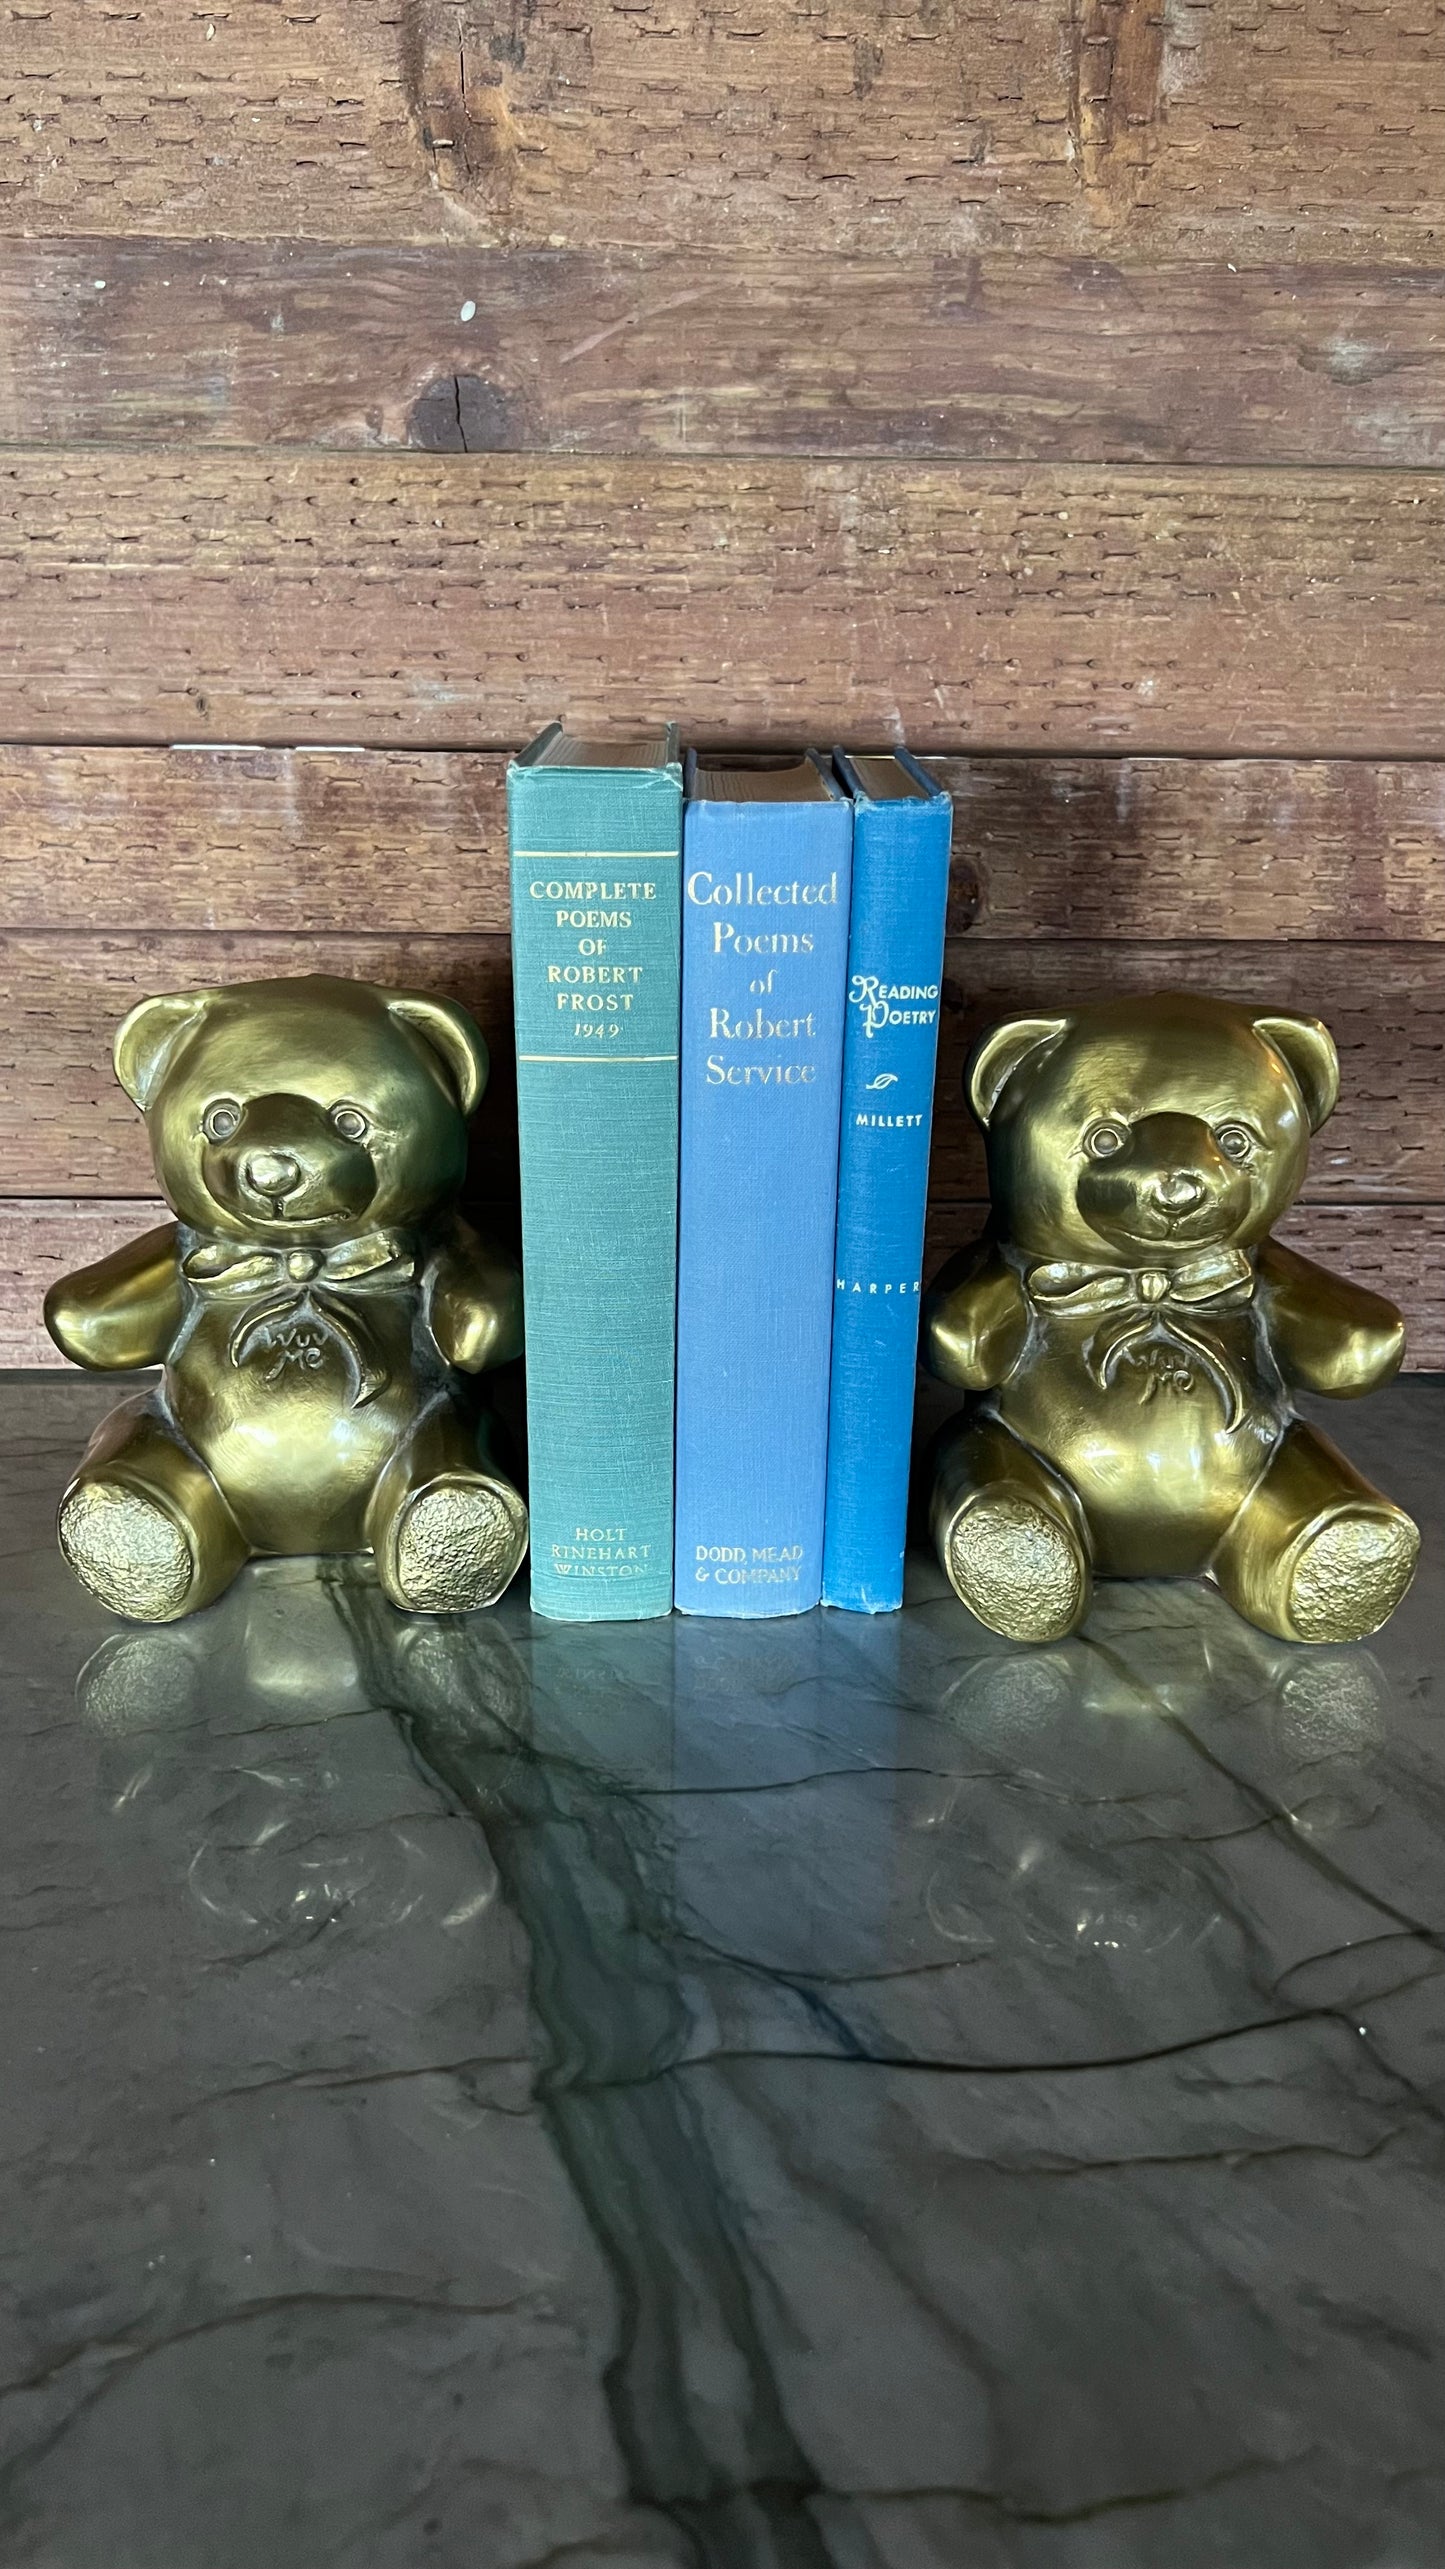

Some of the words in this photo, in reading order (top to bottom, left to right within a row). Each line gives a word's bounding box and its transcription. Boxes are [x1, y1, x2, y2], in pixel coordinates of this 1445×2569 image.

[529, 881, 656, 900] COMPLETE
[687, 871, 837, 906] Collected
[556, 910, 631, 928] POEMS
[578, 938, 608, 956] OF
[713, 921, 814, 955] Poems
[547, 965, 643, 983] ROBERT
[749, 969, 777, 994] of
[848, 975, 938, 1003] READING
[557, 994, 634, 1011] FROST
[709, 1007, 816, 1039] Robert
[859, 1000, 936, 1038] POETRY
[573, 1022, 620, 1038] 1949
[706, 1059, 816, 1086] Service
[856, 1114, 923, 1127] MILLETT
[836, 1279, 920, 1294] HARPER
[576, 1528, 627, 1541] HOLT
[551, 1544, 651, 1560] RINEHART
[696, 1545, 747, 1565] DODD,
[752, 1545, 803, 1562] MEAD
[554, 1563, 647, 1576] WINSTON
[695, 1567, 710, 1582] &
[715, 1566, 801, 1585] COMPANY
